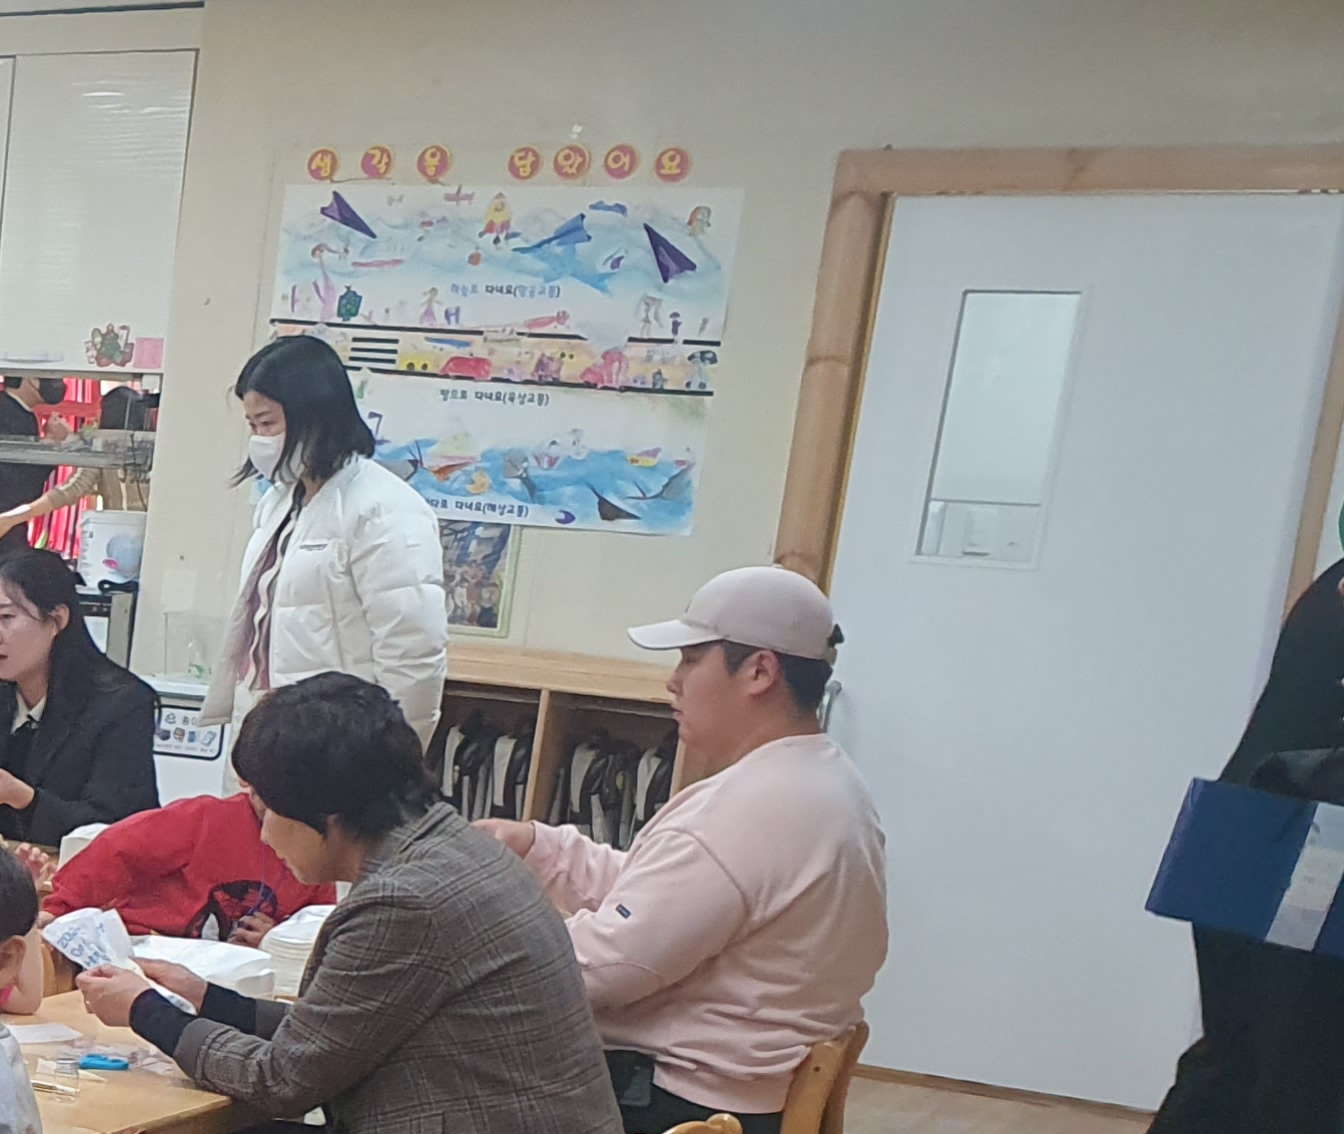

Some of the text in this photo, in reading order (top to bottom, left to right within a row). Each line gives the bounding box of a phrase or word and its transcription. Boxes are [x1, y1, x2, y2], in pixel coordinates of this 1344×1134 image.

[311, 148, 682, 178] 생각을 담았어요
[440, 389, 467, 402] 땅으로
